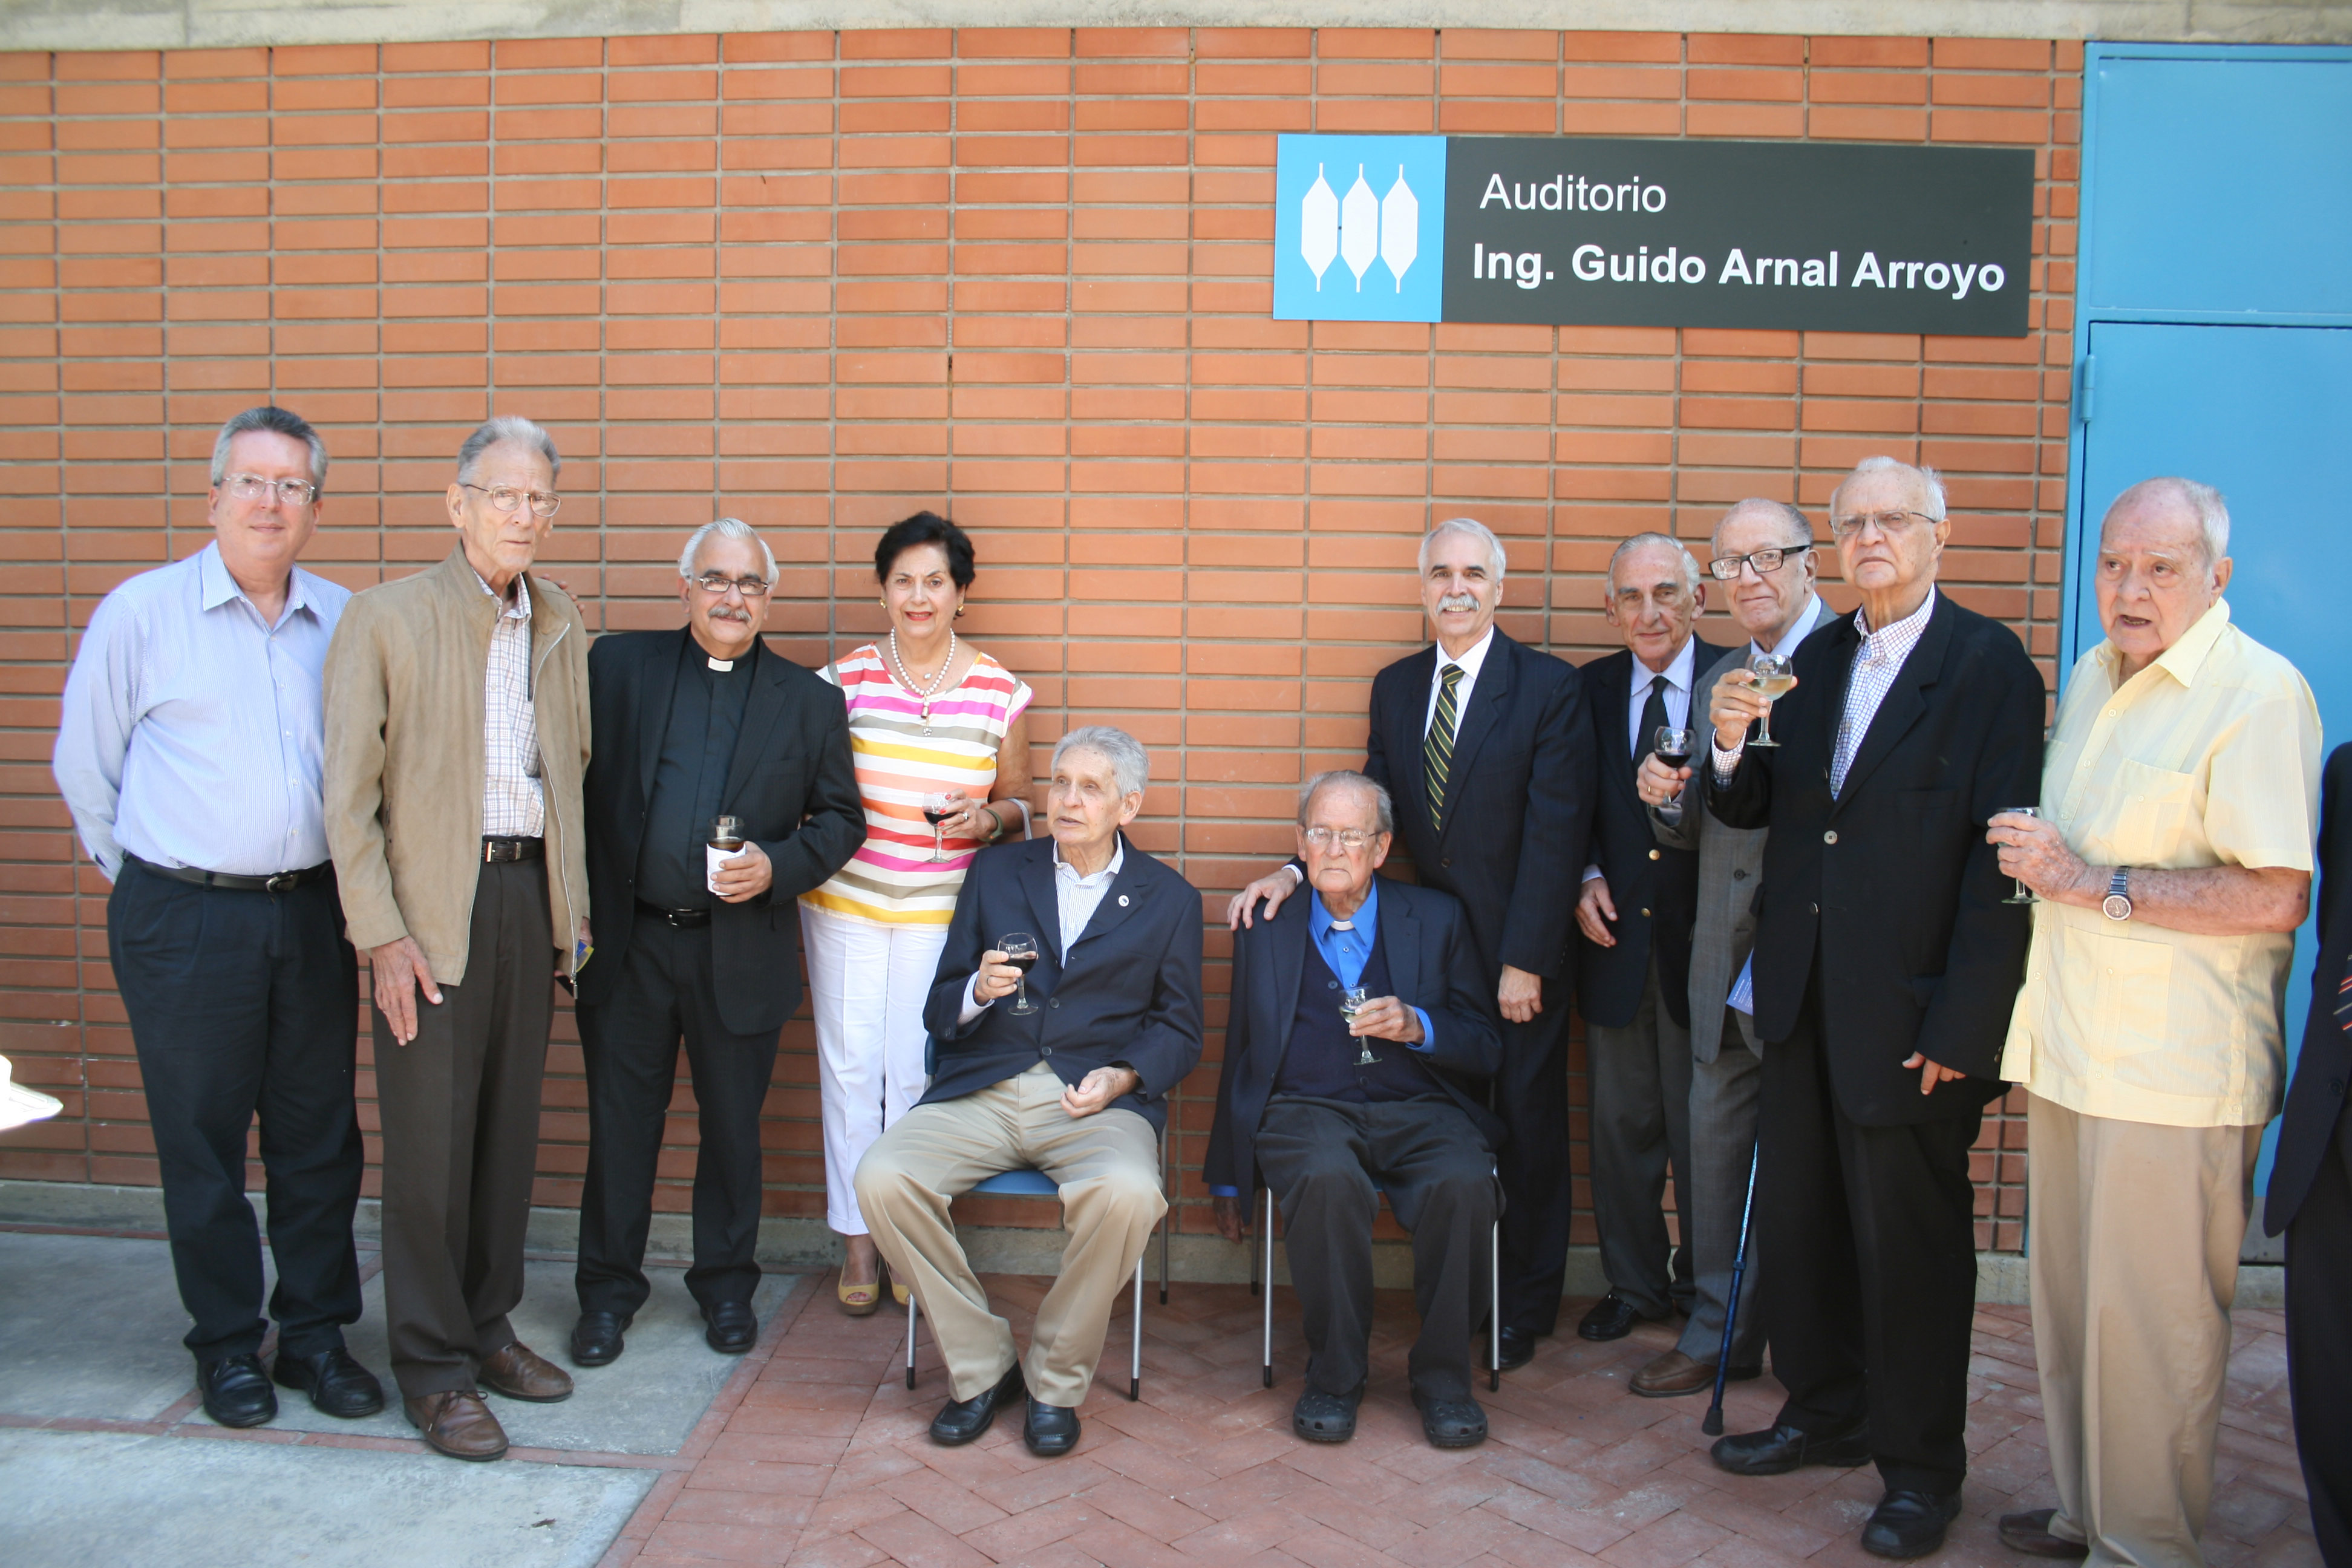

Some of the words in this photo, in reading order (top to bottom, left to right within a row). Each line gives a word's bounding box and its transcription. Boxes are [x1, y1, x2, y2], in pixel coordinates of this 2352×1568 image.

[1479, 173, 1667, 212] Auditorio
[1474, 243, 1554, 289] Ing.
[1572, 244, 1706, 284] Guido
[1718, 248, 1838, 287] Arnal
[1851, 252, 2005, 300] Arroyo
